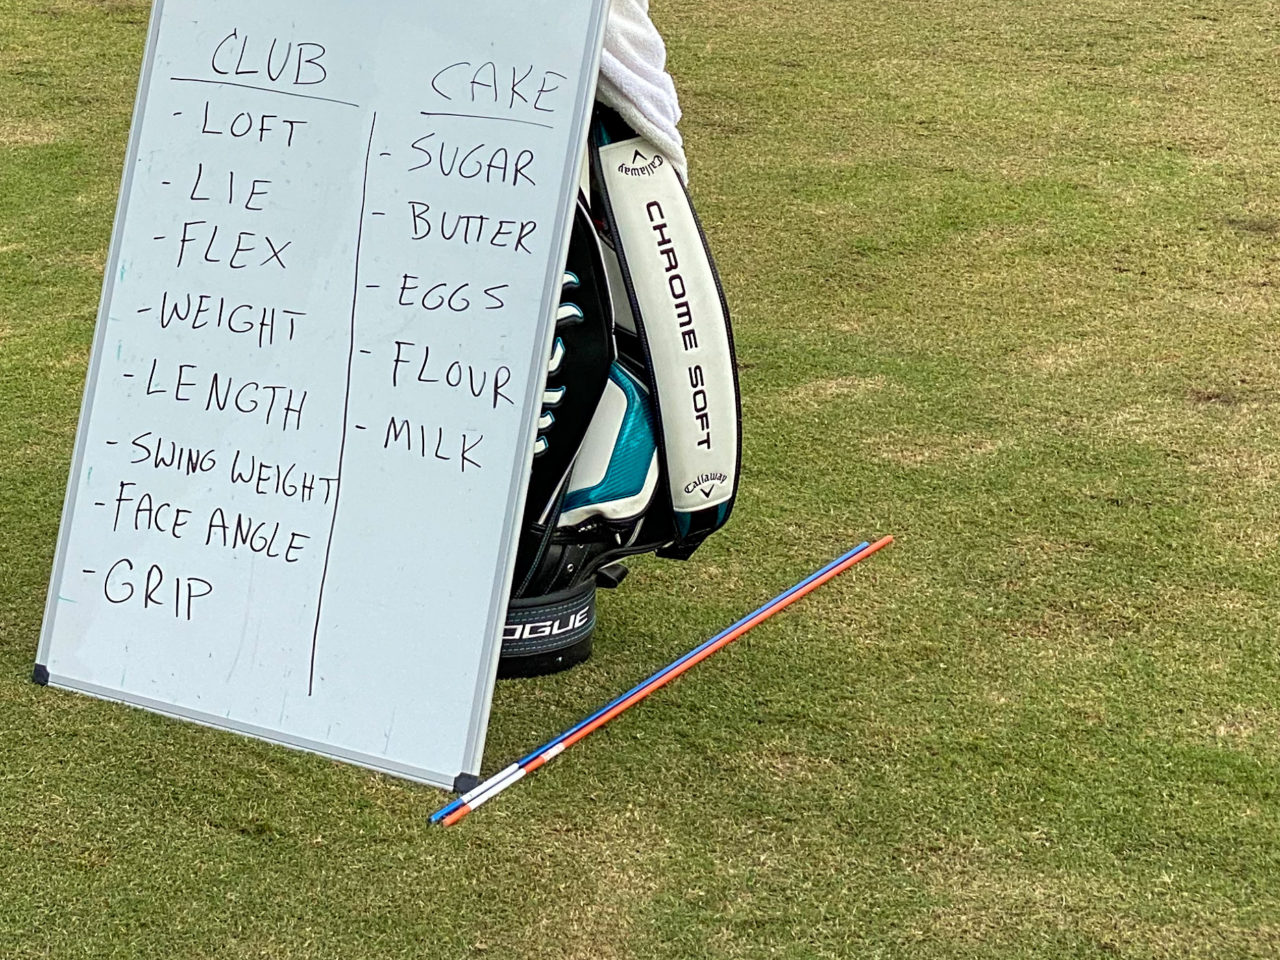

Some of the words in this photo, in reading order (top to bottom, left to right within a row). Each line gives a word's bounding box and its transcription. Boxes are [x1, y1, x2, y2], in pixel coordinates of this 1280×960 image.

[211, 27, 328, 85] CLUB
[431, 61, 568, 113] CAKE
[201, 100, 308, 148] LOFT
[190, 162, 273, 211] LIE
[407, 132, 536, 187] SUGAR
[617, 153, 664, 178] Callaway
[176, 220, 293, 270] FLEX
[407, 201, 537, 255] BUTTER
[160, 291, 308, 348] WEIGHT
[398, 273, 510, 312] EGGS
[645, 200, 699, 352] CHROME
[687, 364, 712, 451] SOFT
[146, 358, 308, 431] LENGTH
[393, 340, 515, 409] FLOUR
[130, 431, 217, 476] SWING
[230, 449, 340, 505] WEIGHT
[383, 416, 484, 473] MILK
[683, 471, 729, 495] Callaway
[113, 480, 193, 539] FACE
[205, 506, 312, 563] ANGLE
[103, 558, 214, 621] GRIP
[501, 605, 590, 640] OGUE
